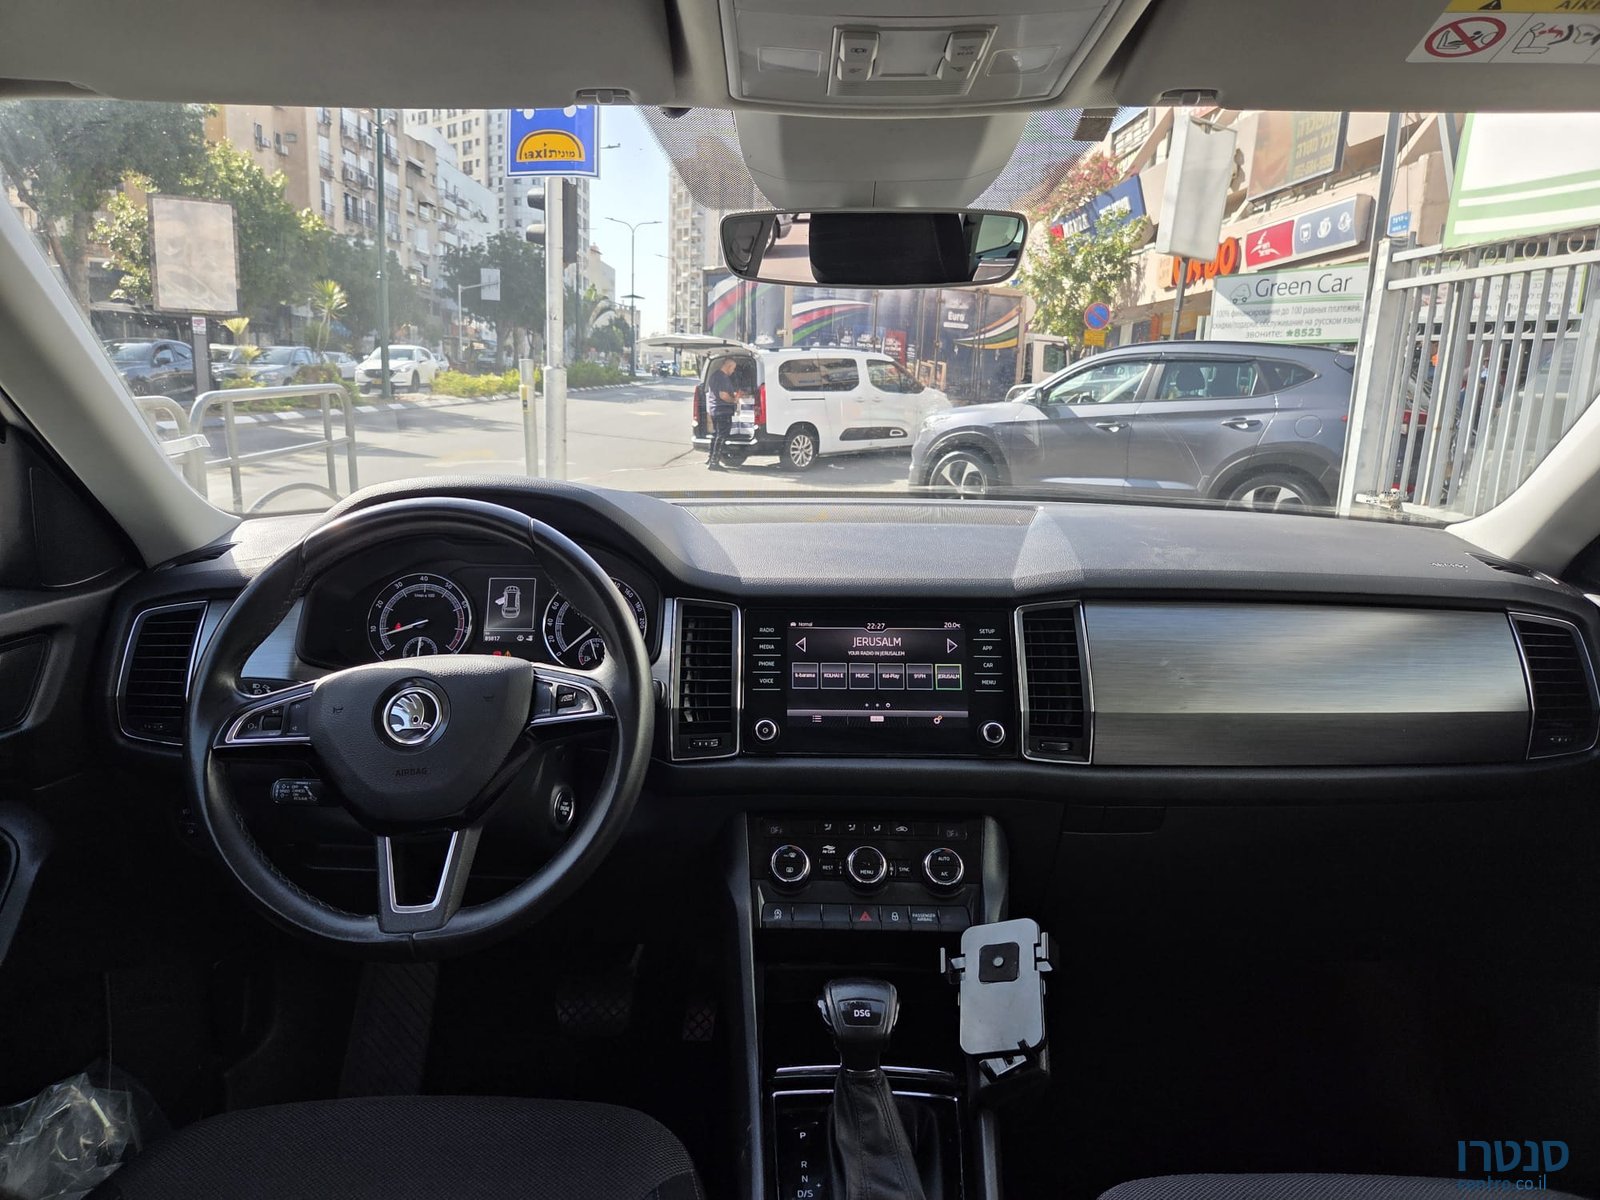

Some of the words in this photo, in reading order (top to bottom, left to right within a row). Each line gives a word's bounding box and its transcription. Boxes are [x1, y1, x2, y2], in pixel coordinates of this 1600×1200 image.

[524, 142, 547, 159] taxi
[548, 148, 576, 158] מונית
[1255, 278, 1312, 298] Green
[1317, 273, 1352, 293] Car
[1281, 307, 1290, 315] до
[1291, 305, 1302, 314] 100
[1303, 305, 1327, 316] равных
[948, 311, 965, 322] Euro
[1314, 317, 1342, 326] русском
[1246, 331, 1282, 339] звоните:
[394, 581, 403, 590] 30
[444, 582, 453, 590] 50
[624, 588, 634, 598] 160
[375, 600, 384, 609] 20
[551, 601, 560, 610] 60
[634, 601, 643, 613] 180
[547, 618, 554, 626] 40
[370, 625, 377, 633] 10
[548, 635, 555, 643] 20
[852, 636, 902, 648] JERUSALM
[394, 768, 428, 777] AIRBAG
[853, 1009, 871, 1018] DSG
[799, 1131, 806, 1139] P
[801, 1175, 809, 1183] N
[797, 1189, 814, 1199] D/S
